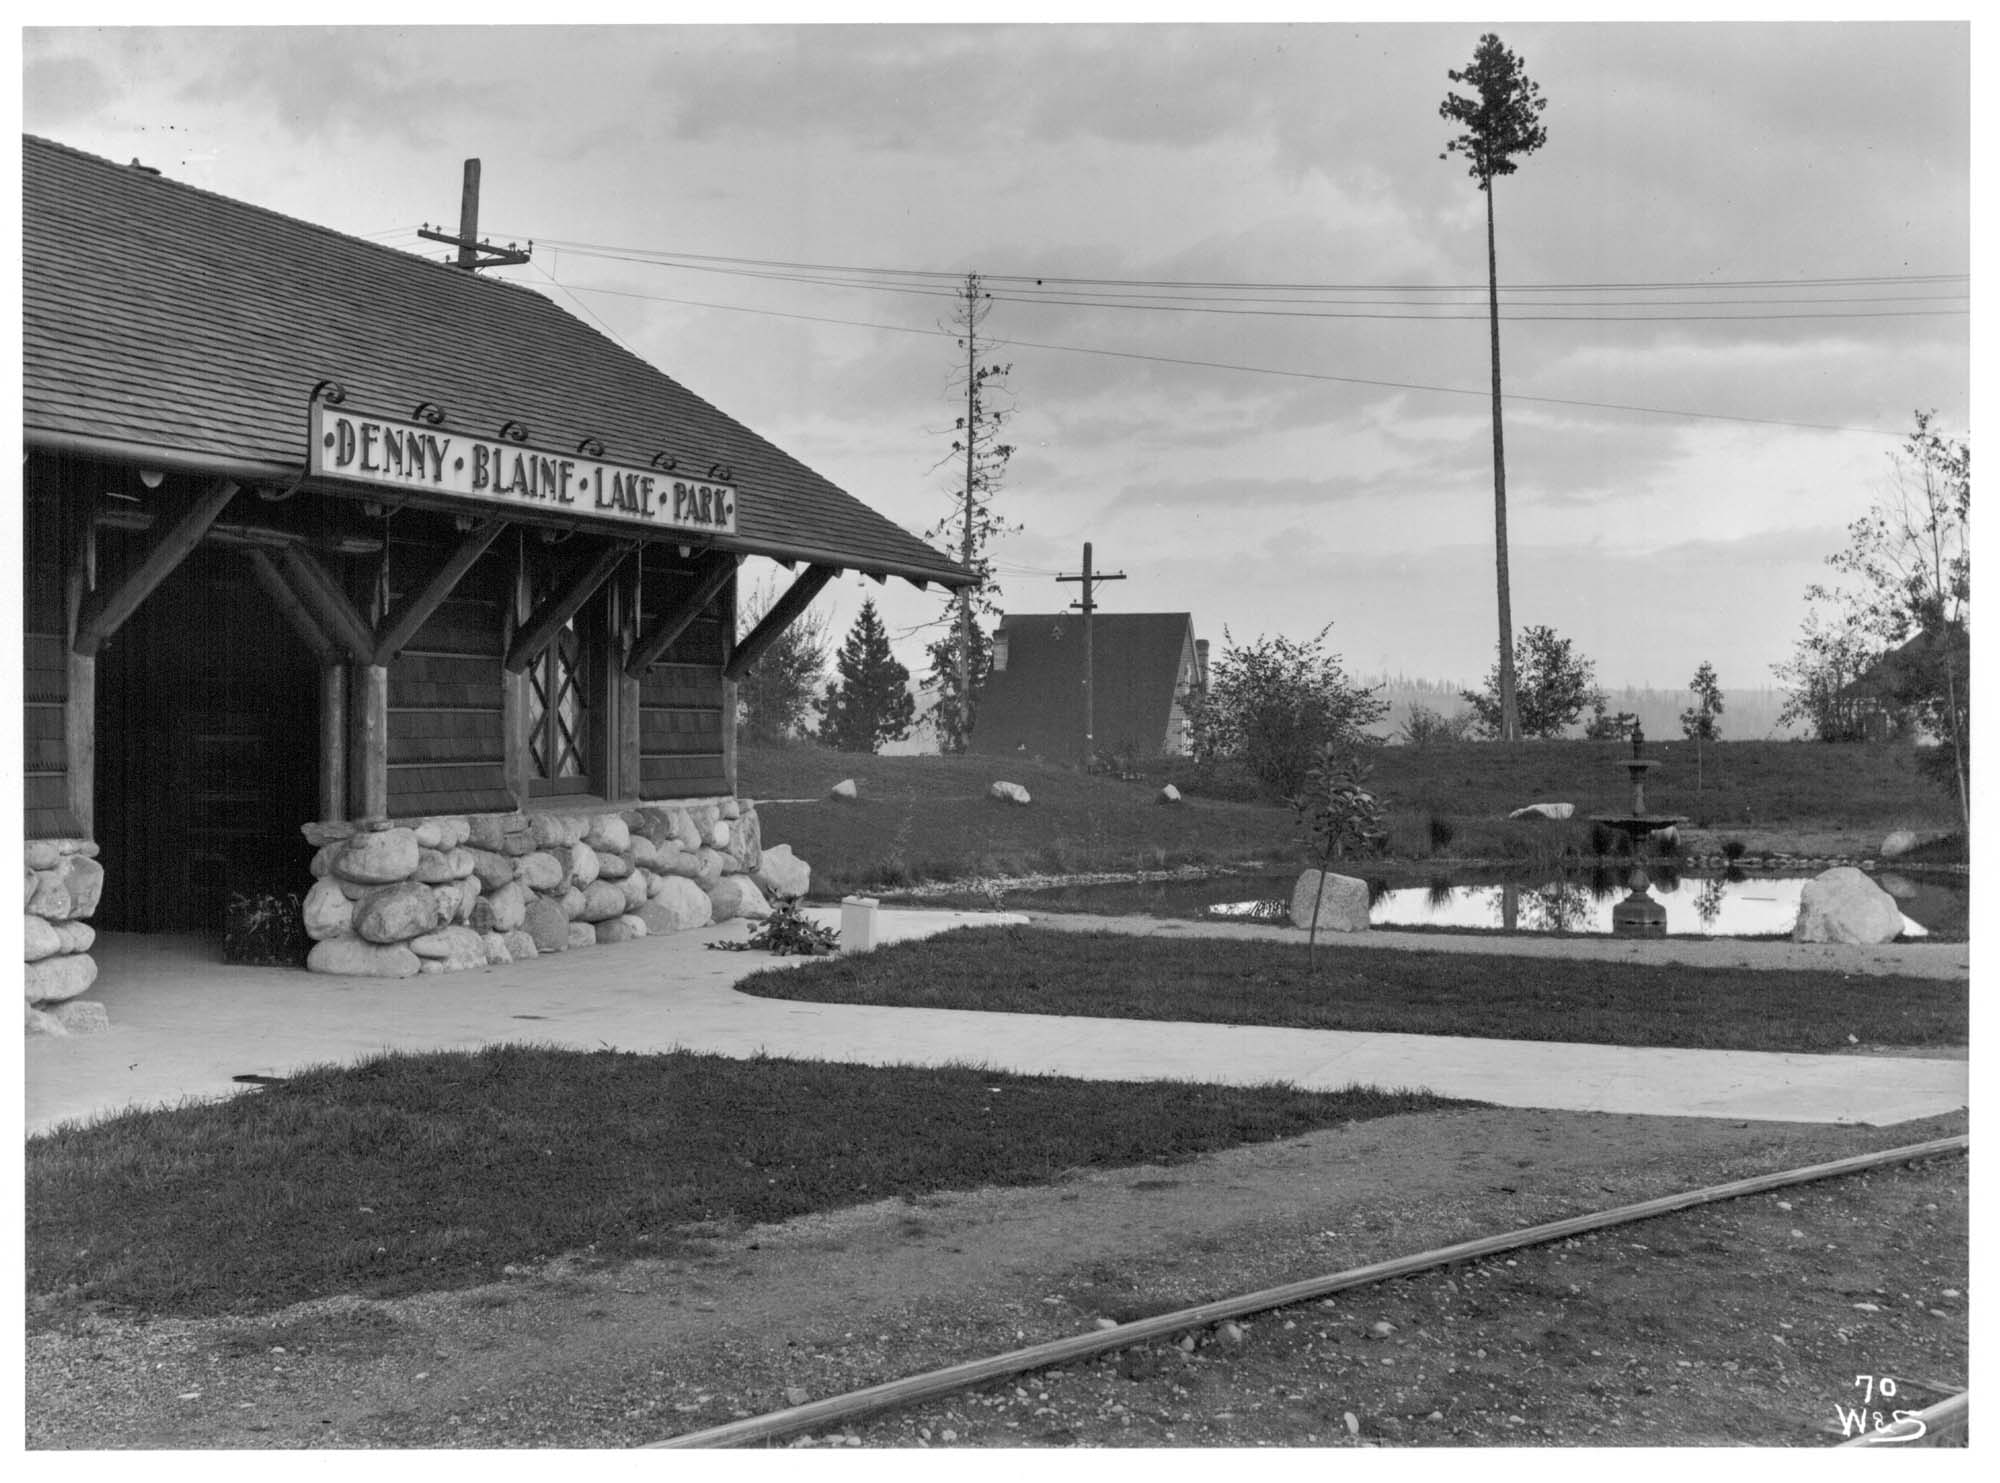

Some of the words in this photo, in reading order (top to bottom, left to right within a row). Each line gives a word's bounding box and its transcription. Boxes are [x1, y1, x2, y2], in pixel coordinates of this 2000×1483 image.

[336, 417, 451, 483] DENNY
[472, 443, 576, 504] BLAINE
[594, 466, 656, 518] LAKE
[673, 481, 728, 526] PARK
